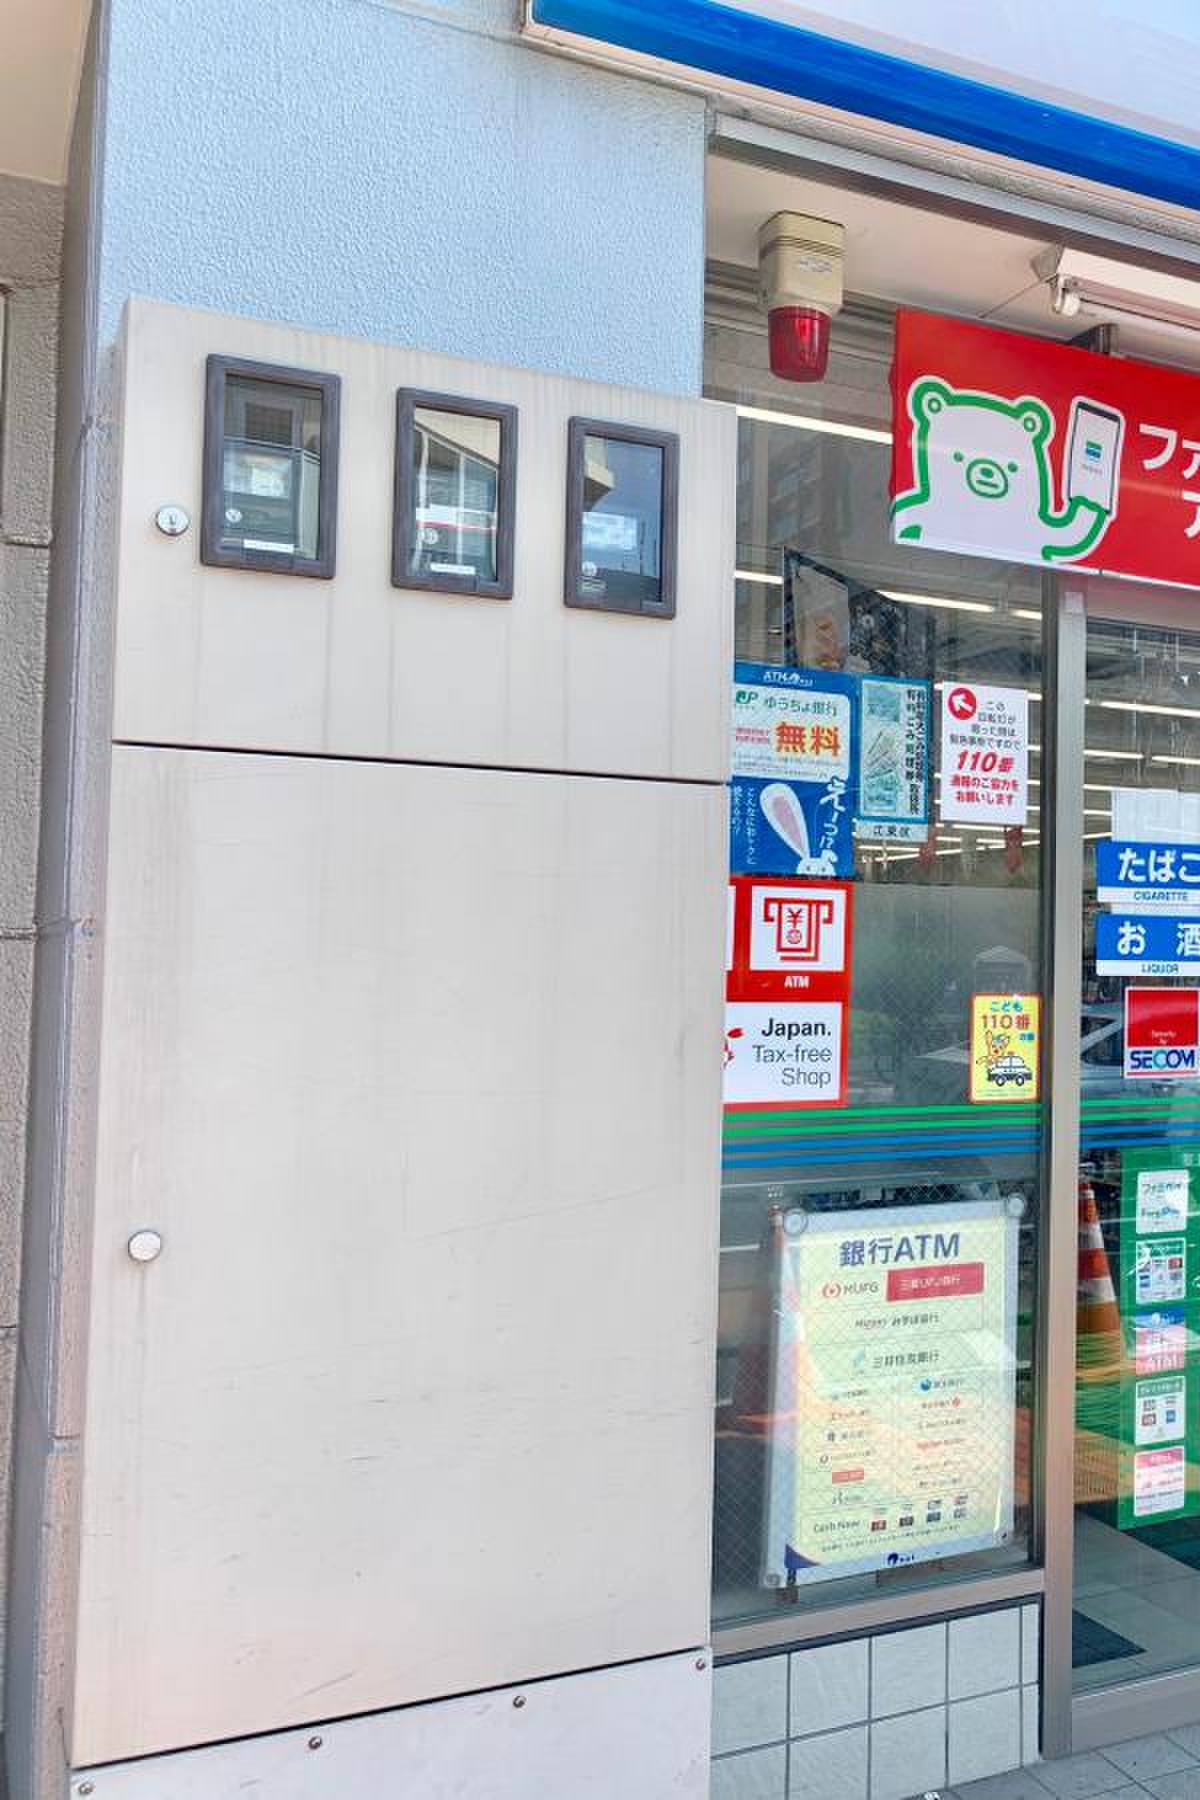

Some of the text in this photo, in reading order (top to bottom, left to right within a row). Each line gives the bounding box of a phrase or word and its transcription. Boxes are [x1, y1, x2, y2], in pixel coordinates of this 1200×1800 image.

[776, 722, 840, 757] 無料
[957, 750, 1014, 773] 110番
[1133, 890, 1189, 901] CIGARETTE
[1141, 963, 1180, 974] LIQUOR
[783, 975, 810, 989] ATM
[991, 1000, 1023, 1013] こども
[761, 1018, 832, 1041] Japan.
[982, 1013, 1031, 1030] 110番
[752, 1044, 833, 1064] Tax-free
[1130, 1050, 1195, 1070] SECOM
[781, 1067, 832, 1089] Shop
[839, 1232, 961, 1268] 銀行ATM
[843, 1281, 880, 1295] MUFG
[872, 1349, 941, 1369] 三井住友銀行
